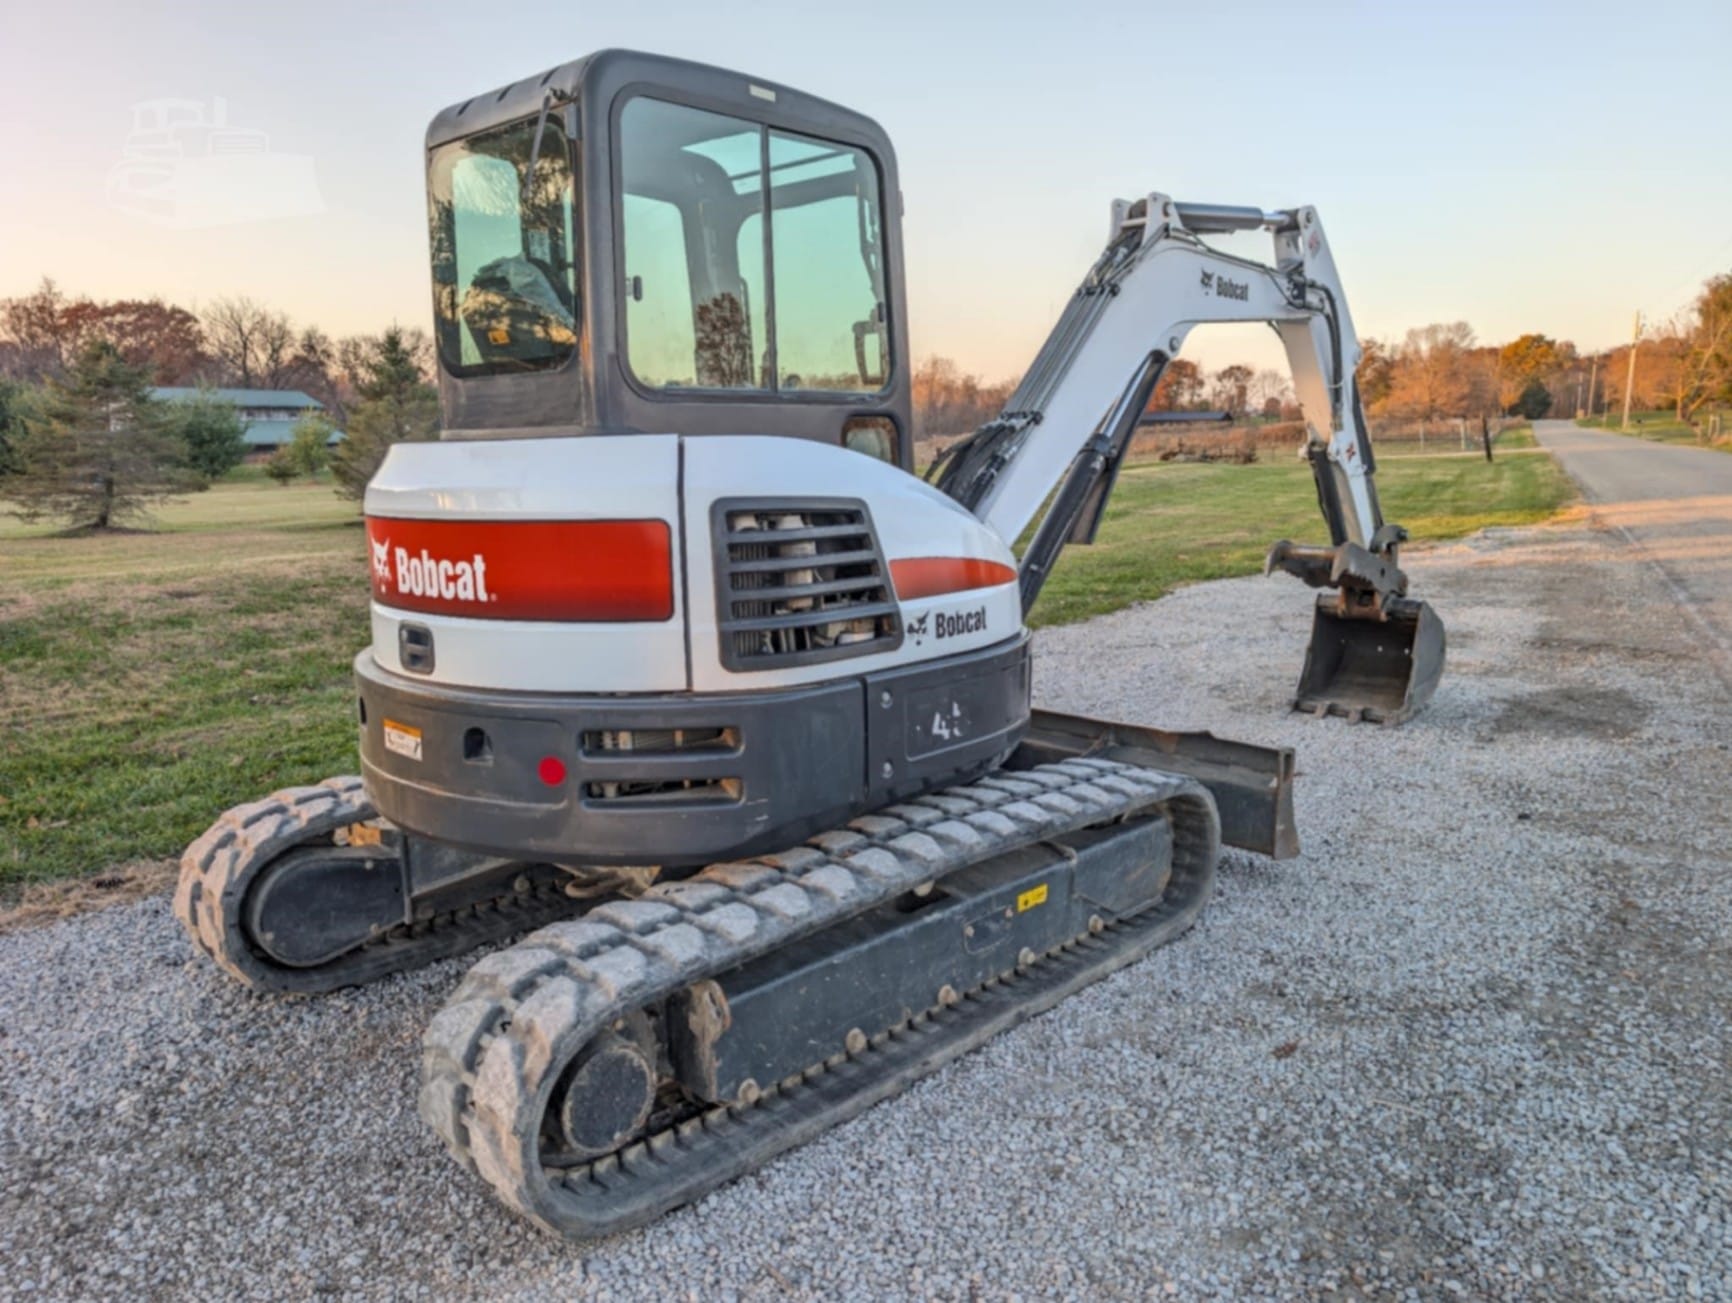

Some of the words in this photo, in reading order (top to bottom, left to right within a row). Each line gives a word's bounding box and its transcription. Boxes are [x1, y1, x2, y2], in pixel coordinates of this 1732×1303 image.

[1216, 275, 1249, 302] Bobcat
[395, 546, 488, 602] Bobcat
[935, 606, 987, 640] Bobcat
